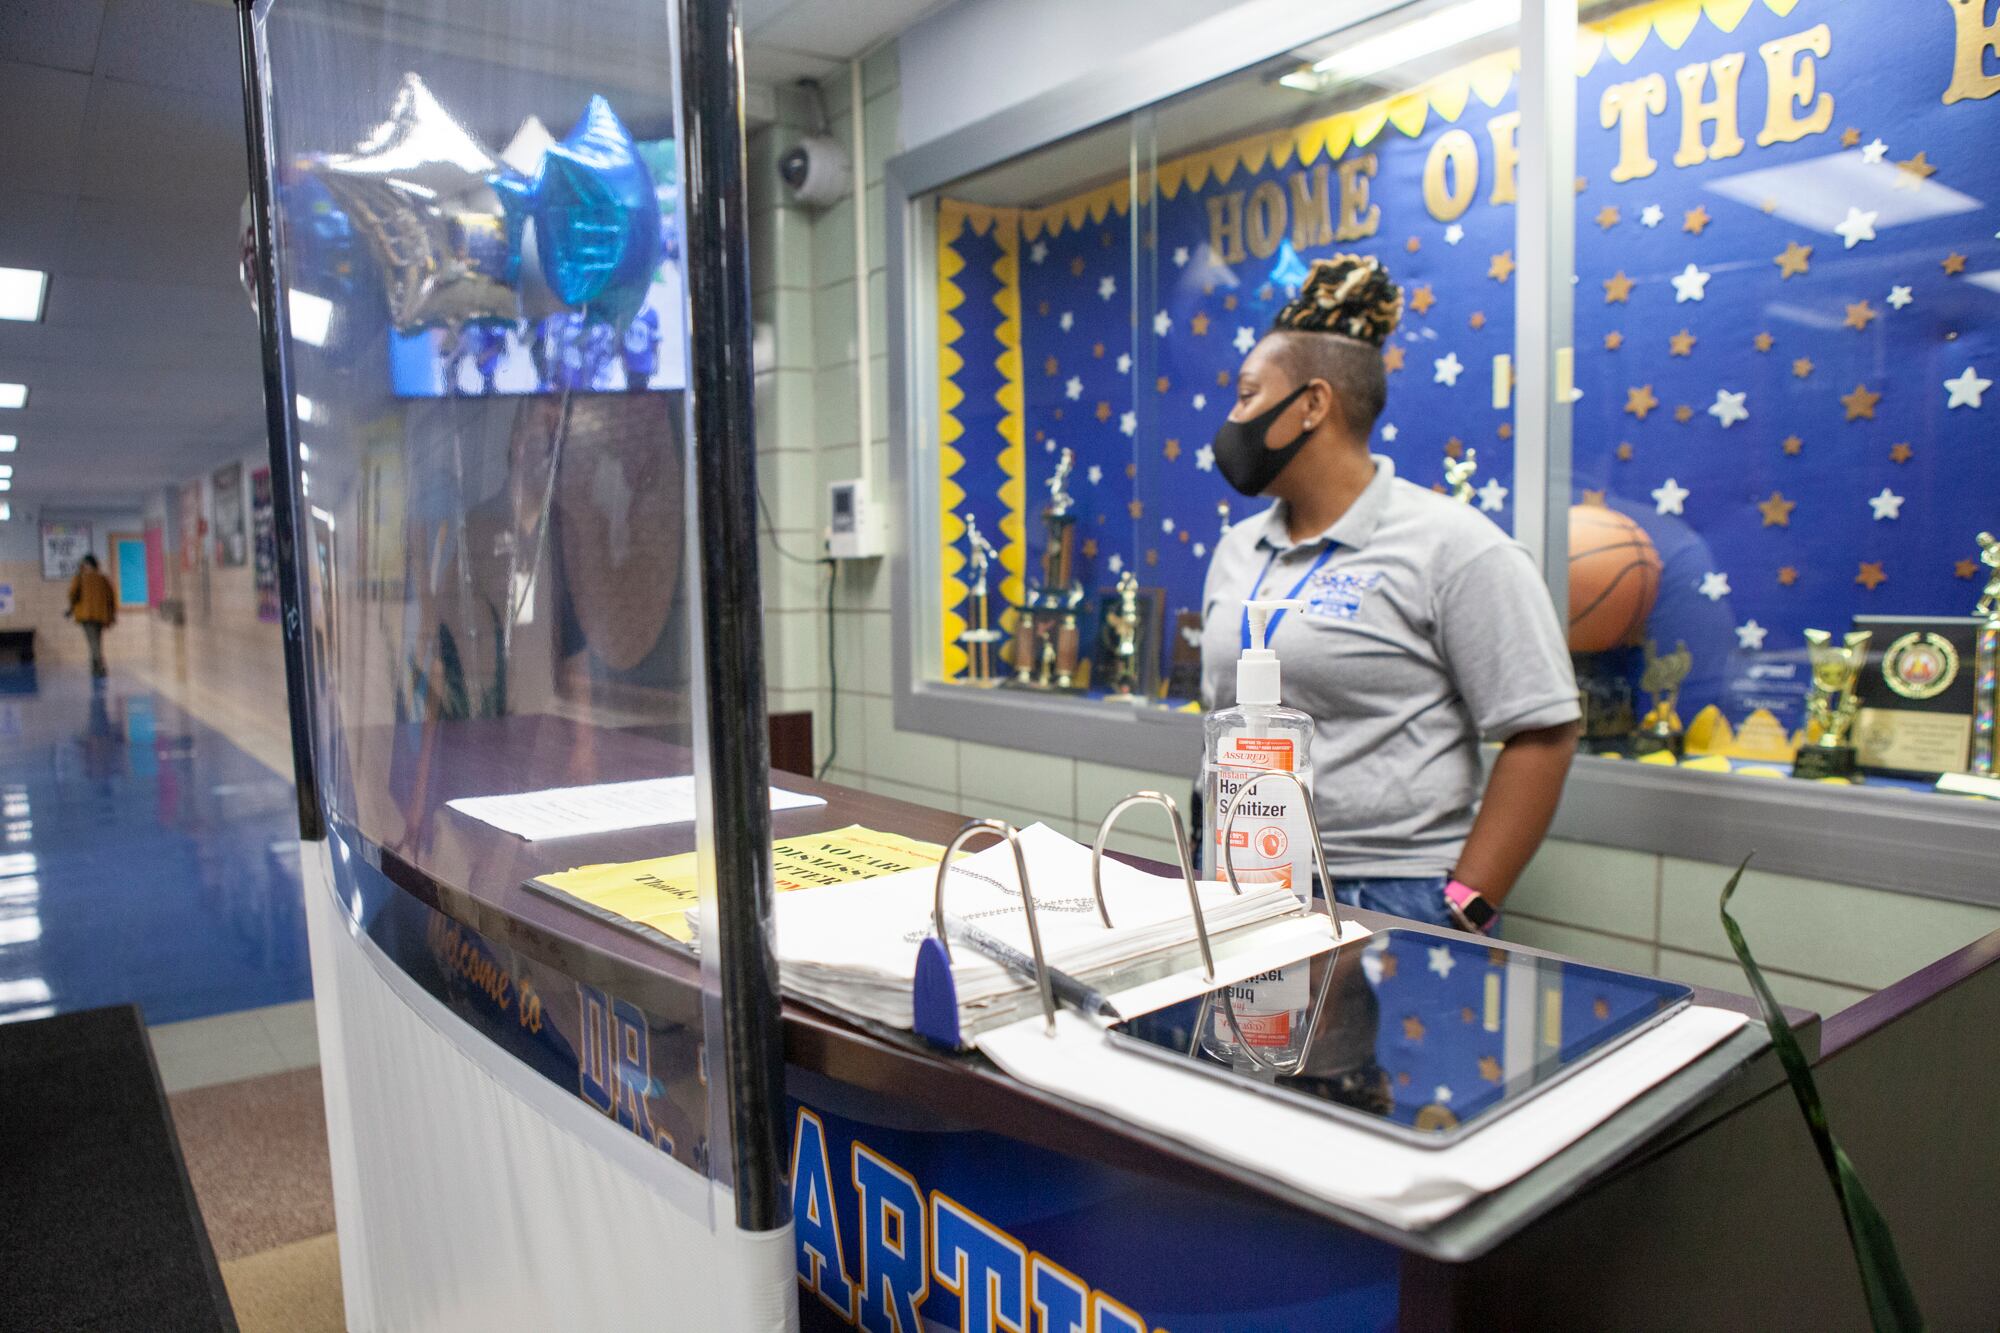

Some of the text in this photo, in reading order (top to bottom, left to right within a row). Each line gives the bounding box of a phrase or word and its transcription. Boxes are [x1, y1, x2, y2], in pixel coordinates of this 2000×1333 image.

[1206, 154, 1381, 264] HOME
[1600, 23, 1834, 183] THE
[1223, 751, 1266, 761] ASSURED
[1220, 771, 1248, 779] Instant
[1220, 779, 1257, 796] Had
[1220, 799, 1287, 817] Snitizer
[773, 845, 878, 880] DISMISSA
[848, 854, 912, 872] EARL
[633, 873, 693, 899] Thank
